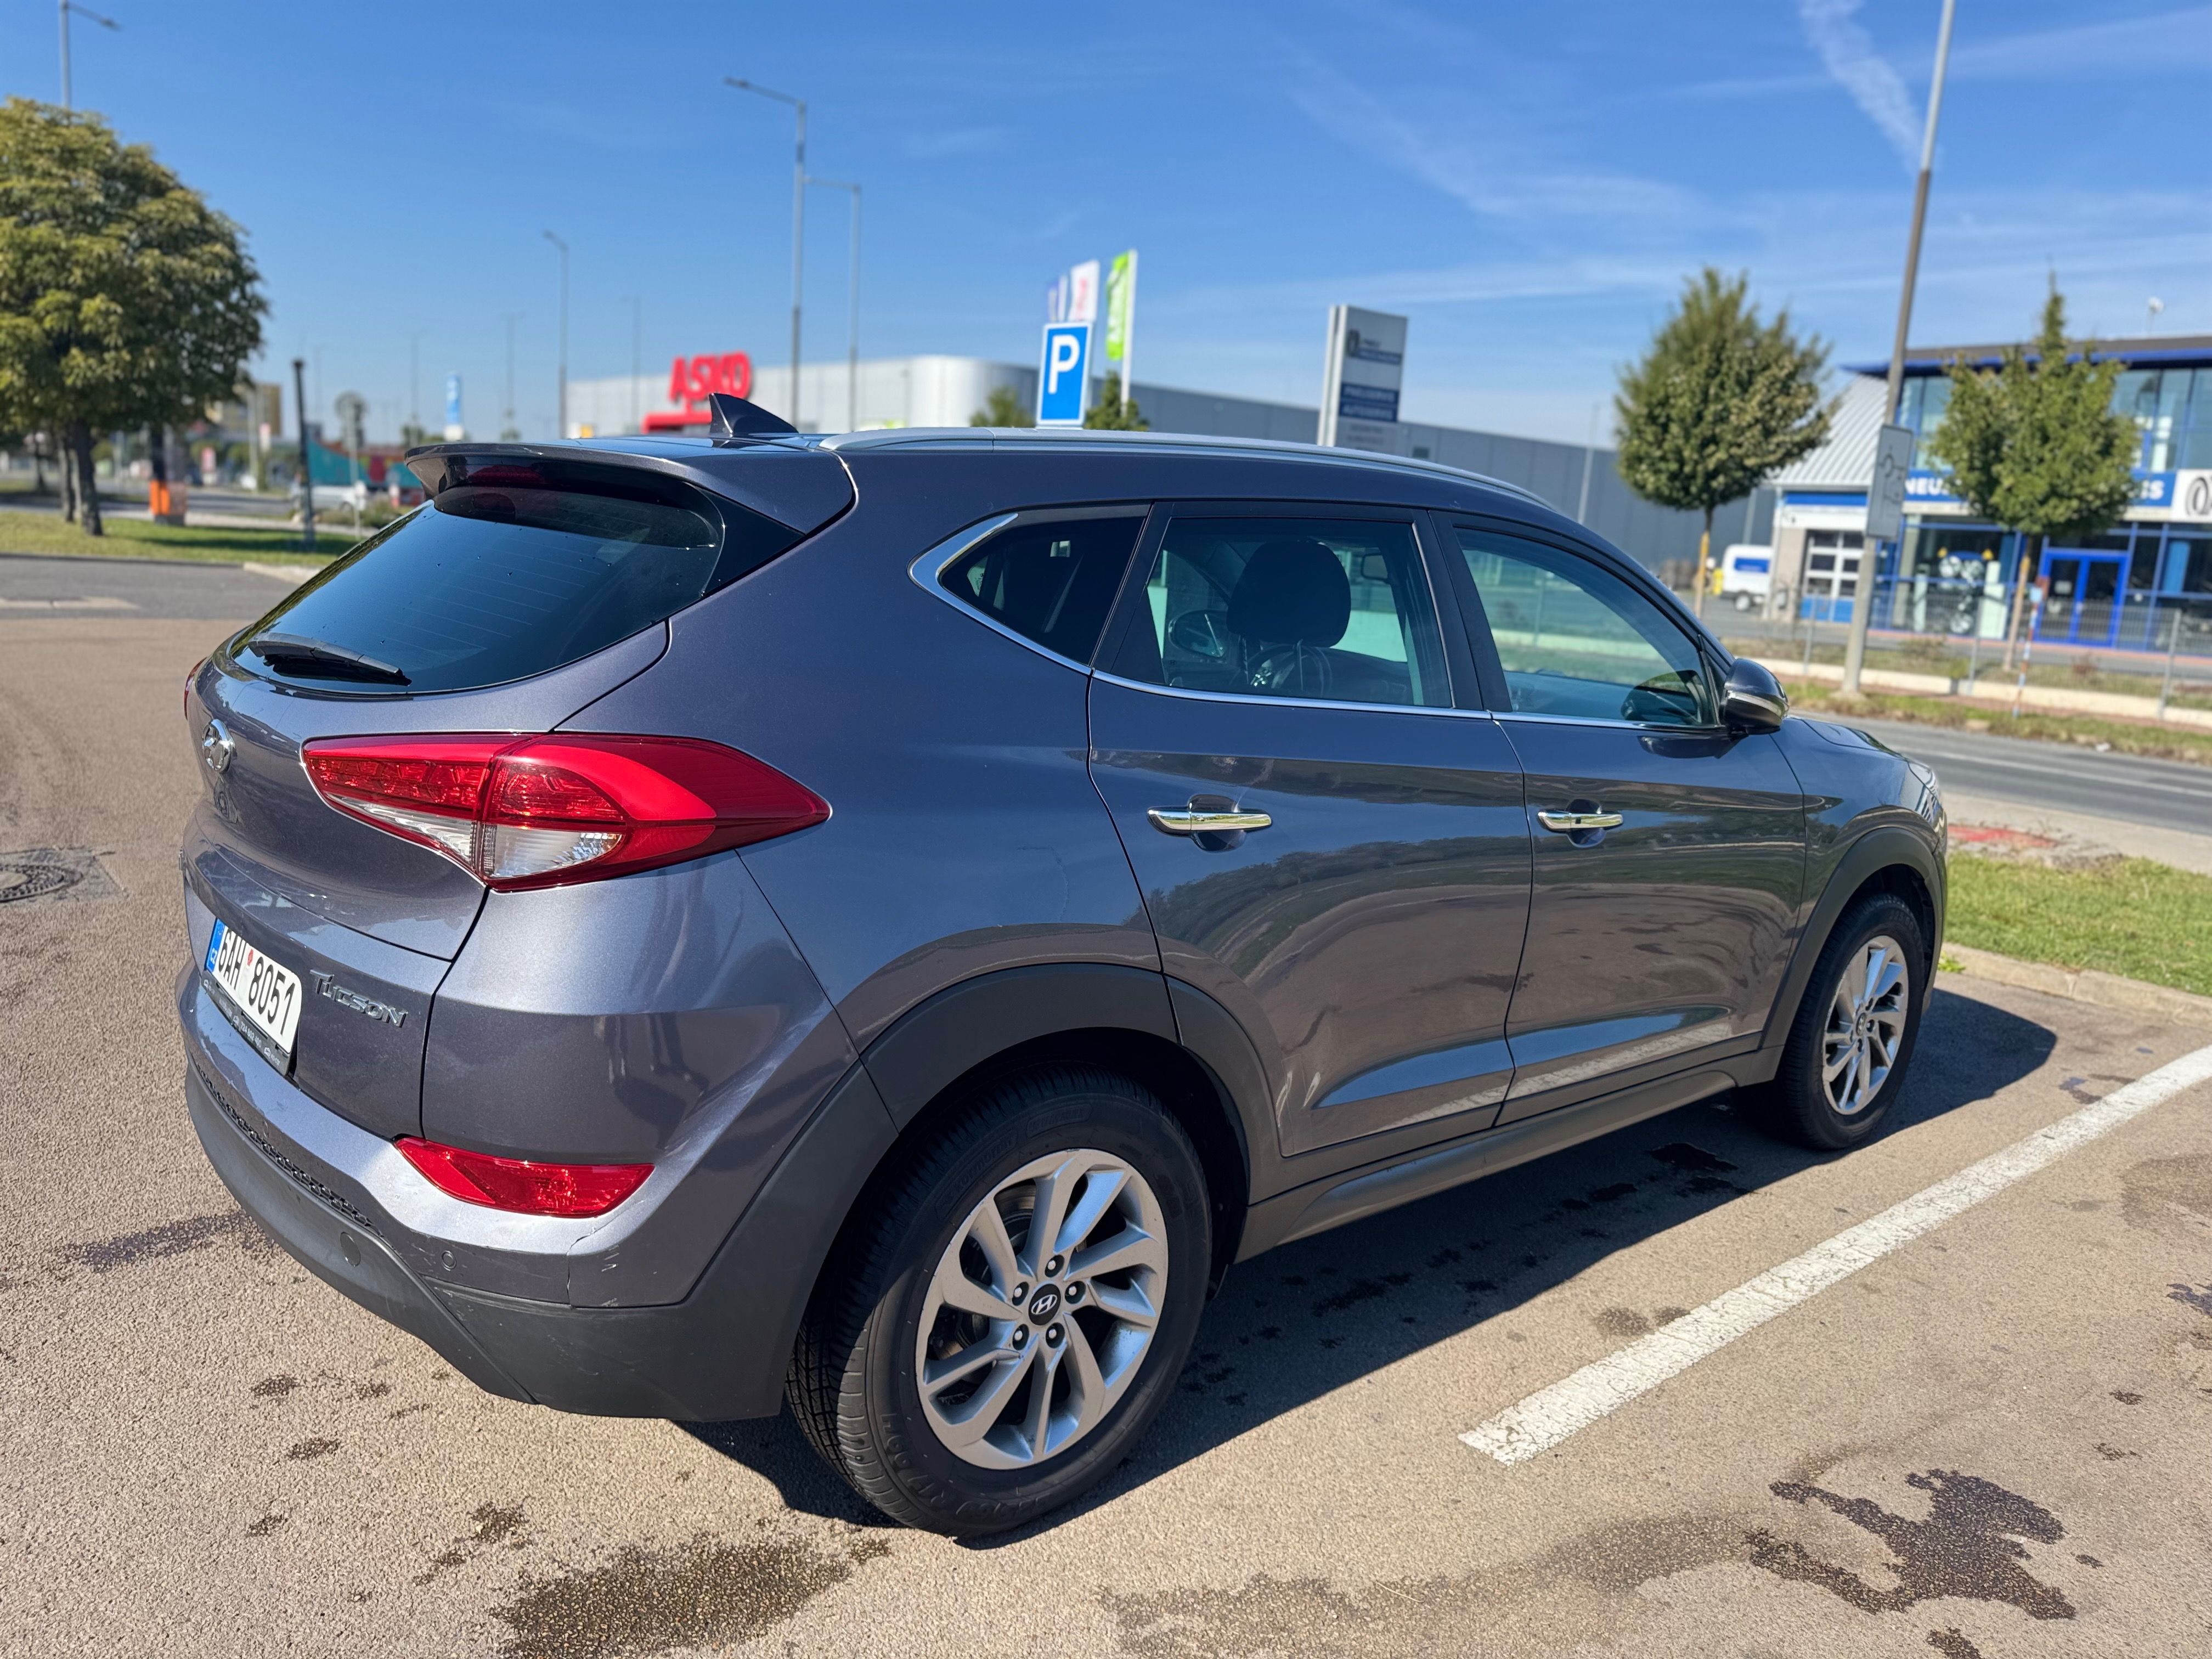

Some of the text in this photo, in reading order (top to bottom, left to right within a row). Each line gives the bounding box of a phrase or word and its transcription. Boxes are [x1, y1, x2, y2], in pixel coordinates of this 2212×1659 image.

[1048, 334, 1080, 394] P
[218, 928, 296, 1036] 6AH 8051
